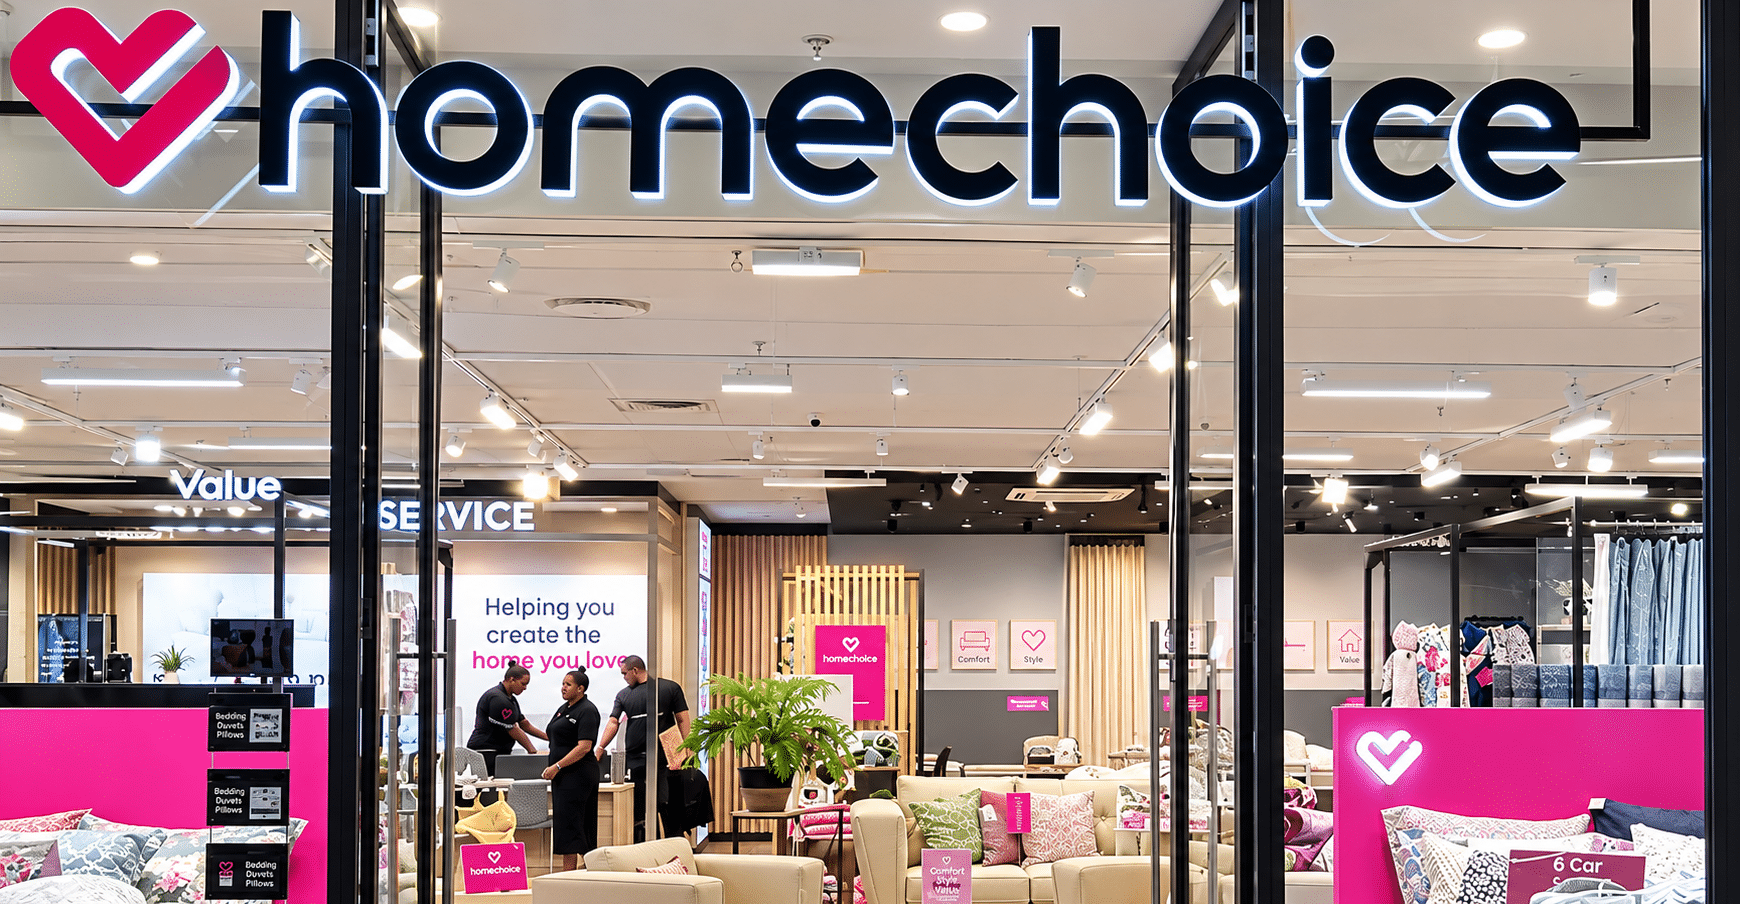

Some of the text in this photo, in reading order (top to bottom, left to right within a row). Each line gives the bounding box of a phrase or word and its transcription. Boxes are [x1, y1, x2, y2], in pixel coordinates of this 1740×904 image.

[258, 10, 1581, 208] homechoice
[170, 469, 282, 500] Value
[485, 597, 615, 620] Helping you
[486, 625, 601, 643] create the
[472, 651, 534, 669] home
[540, 655, 579, 673] you
[822, 654, 878, 663] homechoice
[957, 655, 990, 663] Comfort
[1023, 655, 1044, 665] Style
[1339, 655, 1361, 664] Value
[214, 787, 245, 796] Bedding
[245, 861, 277, 870] Bedding
[470, 865, 521, 875] homechoice
[1553, 856, 1604, 874] 6 Car
